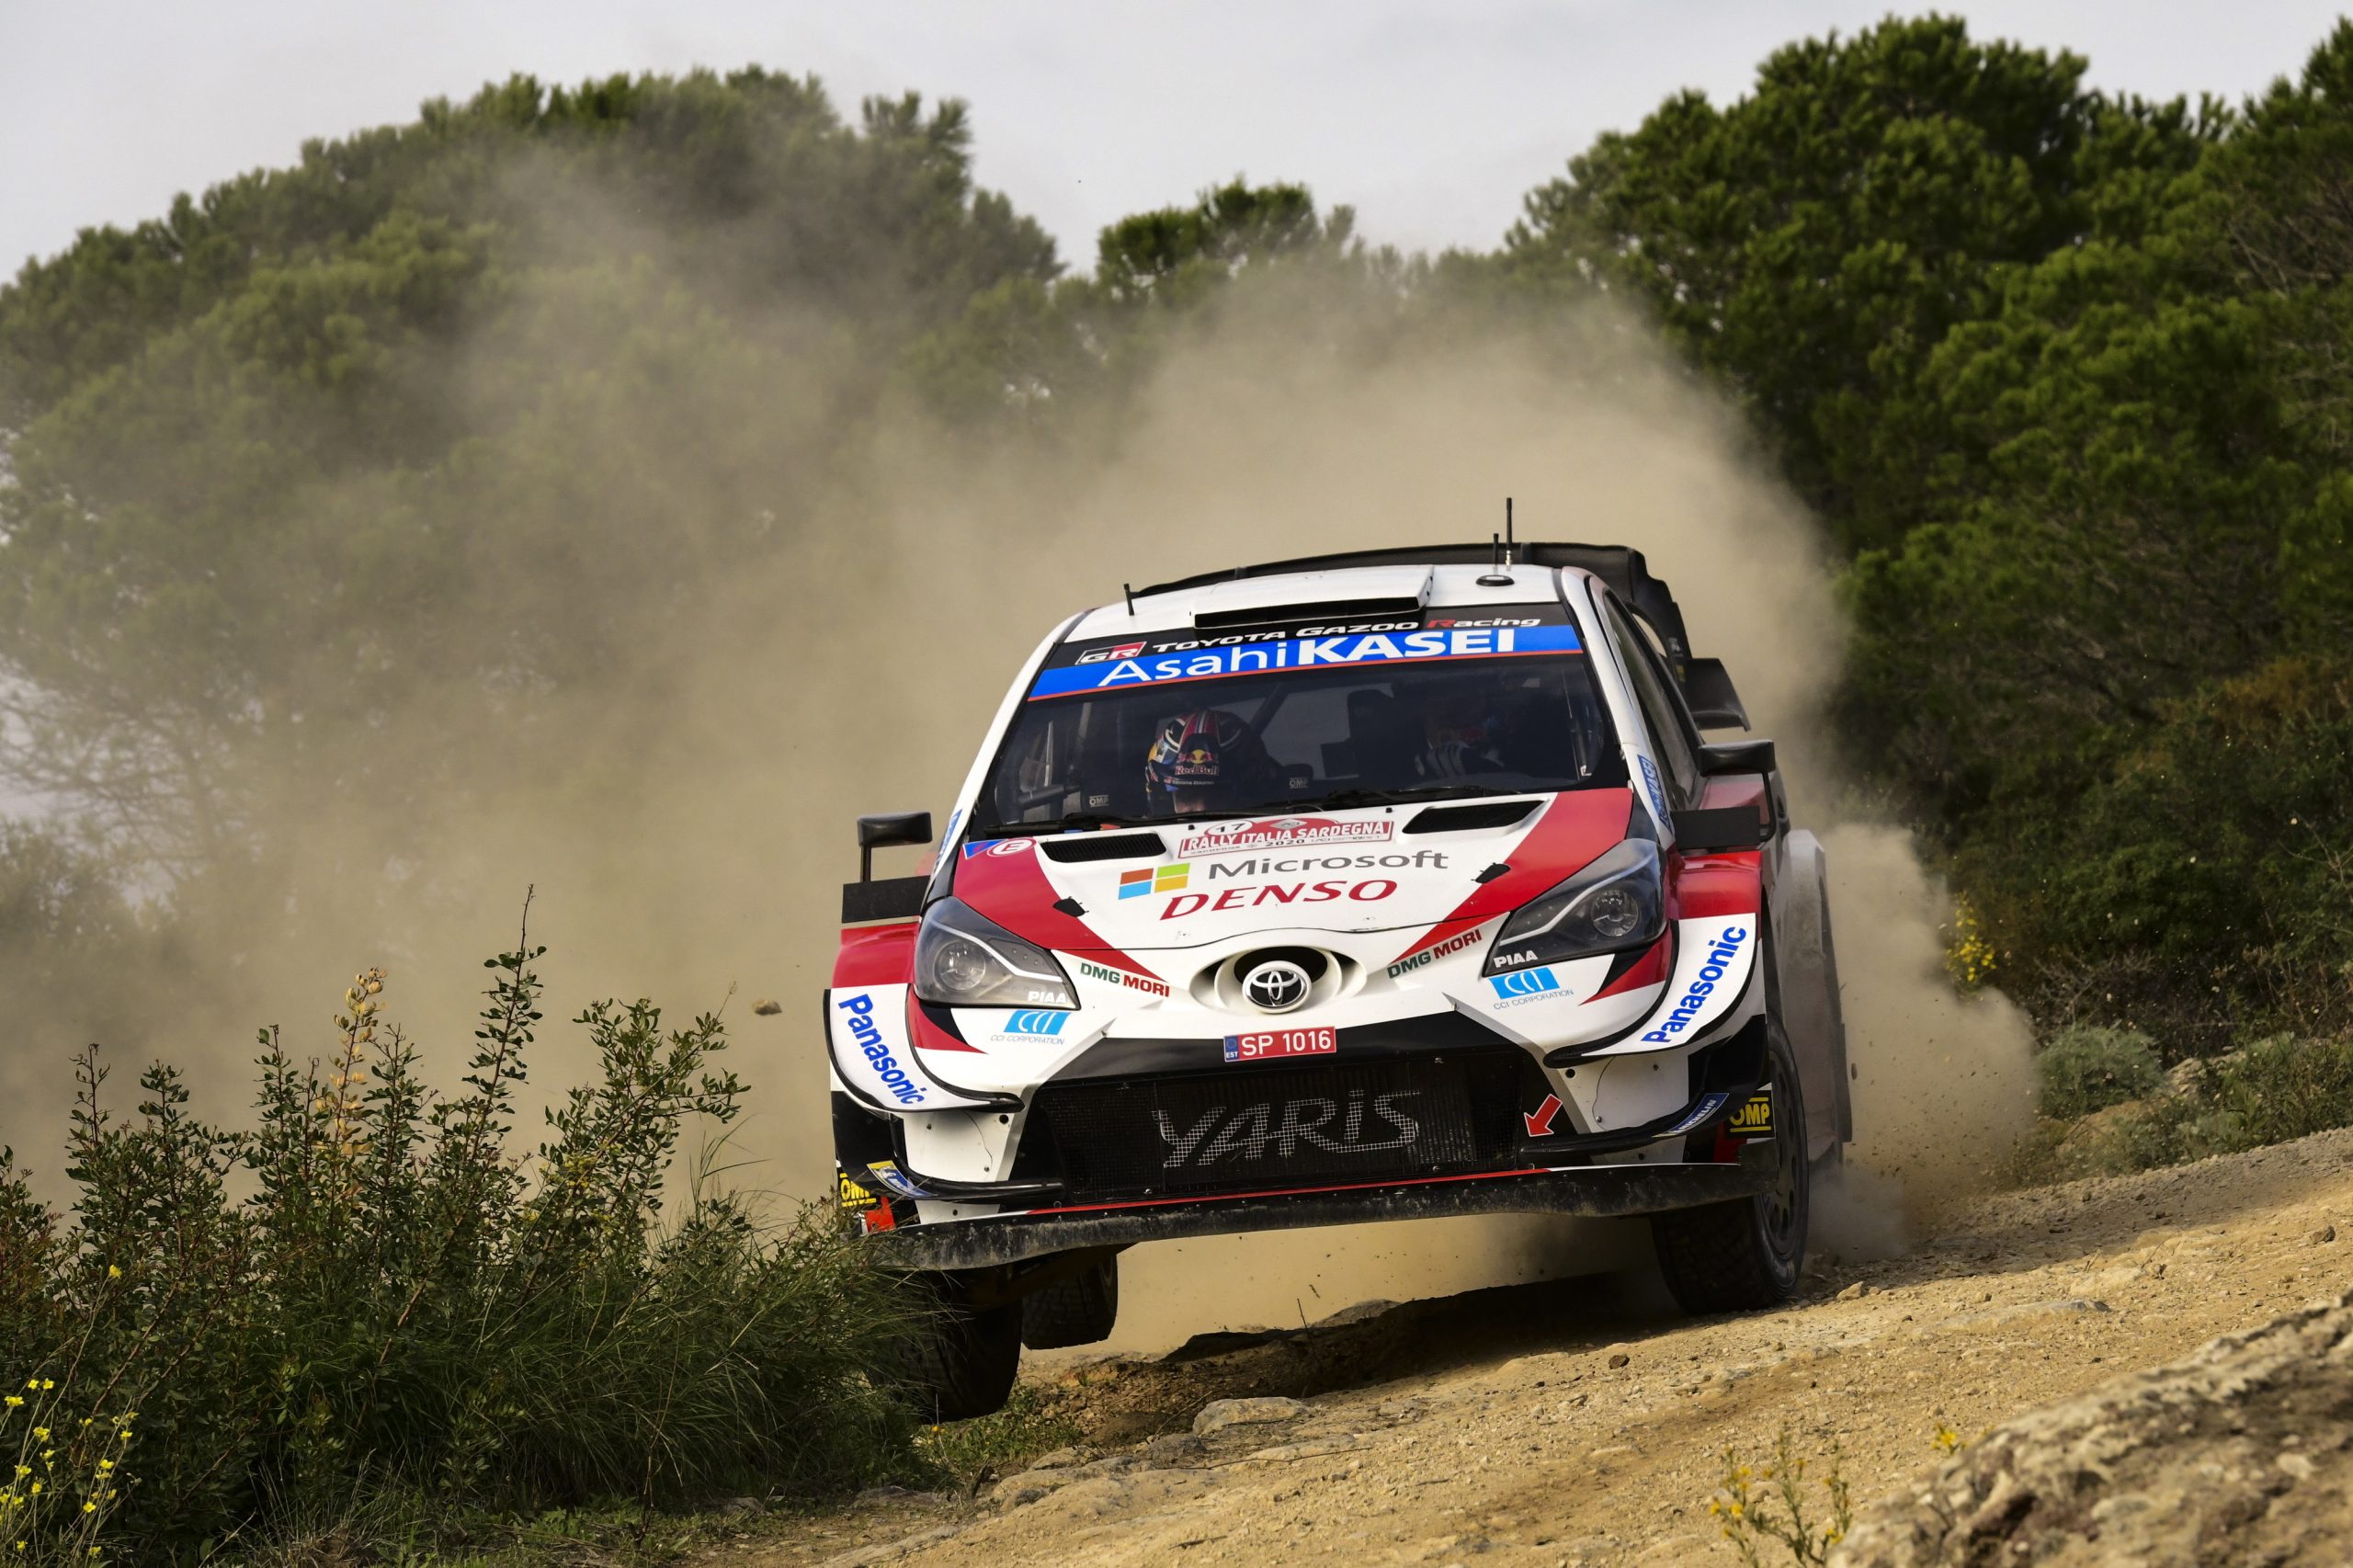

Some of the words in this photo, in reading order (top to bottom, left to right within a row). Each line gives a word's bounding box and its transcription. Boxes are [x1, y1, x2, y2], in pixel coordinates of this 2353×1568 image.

[1078, 646, 1141, 664] GR
[1153, 631, 1286, 653] TOYOTA
[1296, 621, 1419, 637] GAZOO
[1427, 618, 1541, 629] Racing
[1188, 834, 1238, 850] RALLY
[1240, 829, 1292, 845] ITALIA
[1296, 821, 1385, 838] SARDEGNA
[1216, 823, 1246, 833] 17
[1266, 838, 1305, 846] 2020
[1209, 850, 1449, 880] Microsoft
[1160, 880, 1398, 920] DENSO
[1387, 951, 1431, 979] DMG
[1433, 929, 1483, 960] MORI
[1494, 950, 1538, 968] PIAA
[1080, 962, 1120, 983] DMG
[1123, 974, 1170, 997] MORI
[1641, 926, 1746, 1042] Panasonic
[1028, 991, 1067, 1004] PIAA
[1494, 1000, 1510, 1010] CCI
[1512, 989, 1574, 1006] CORPORATION
[838, 994, 926, 1104] Panasonic
[1006, 1035, 1065, 1045] CORPORATION
[1241, 1035, 1274, 1056] SP
[1282, 1030, 1332, 1052] 1016
[1677, 1099, 1717, 1130] MICHELIN
[1730, 1103, 1770, 1125] OMP
